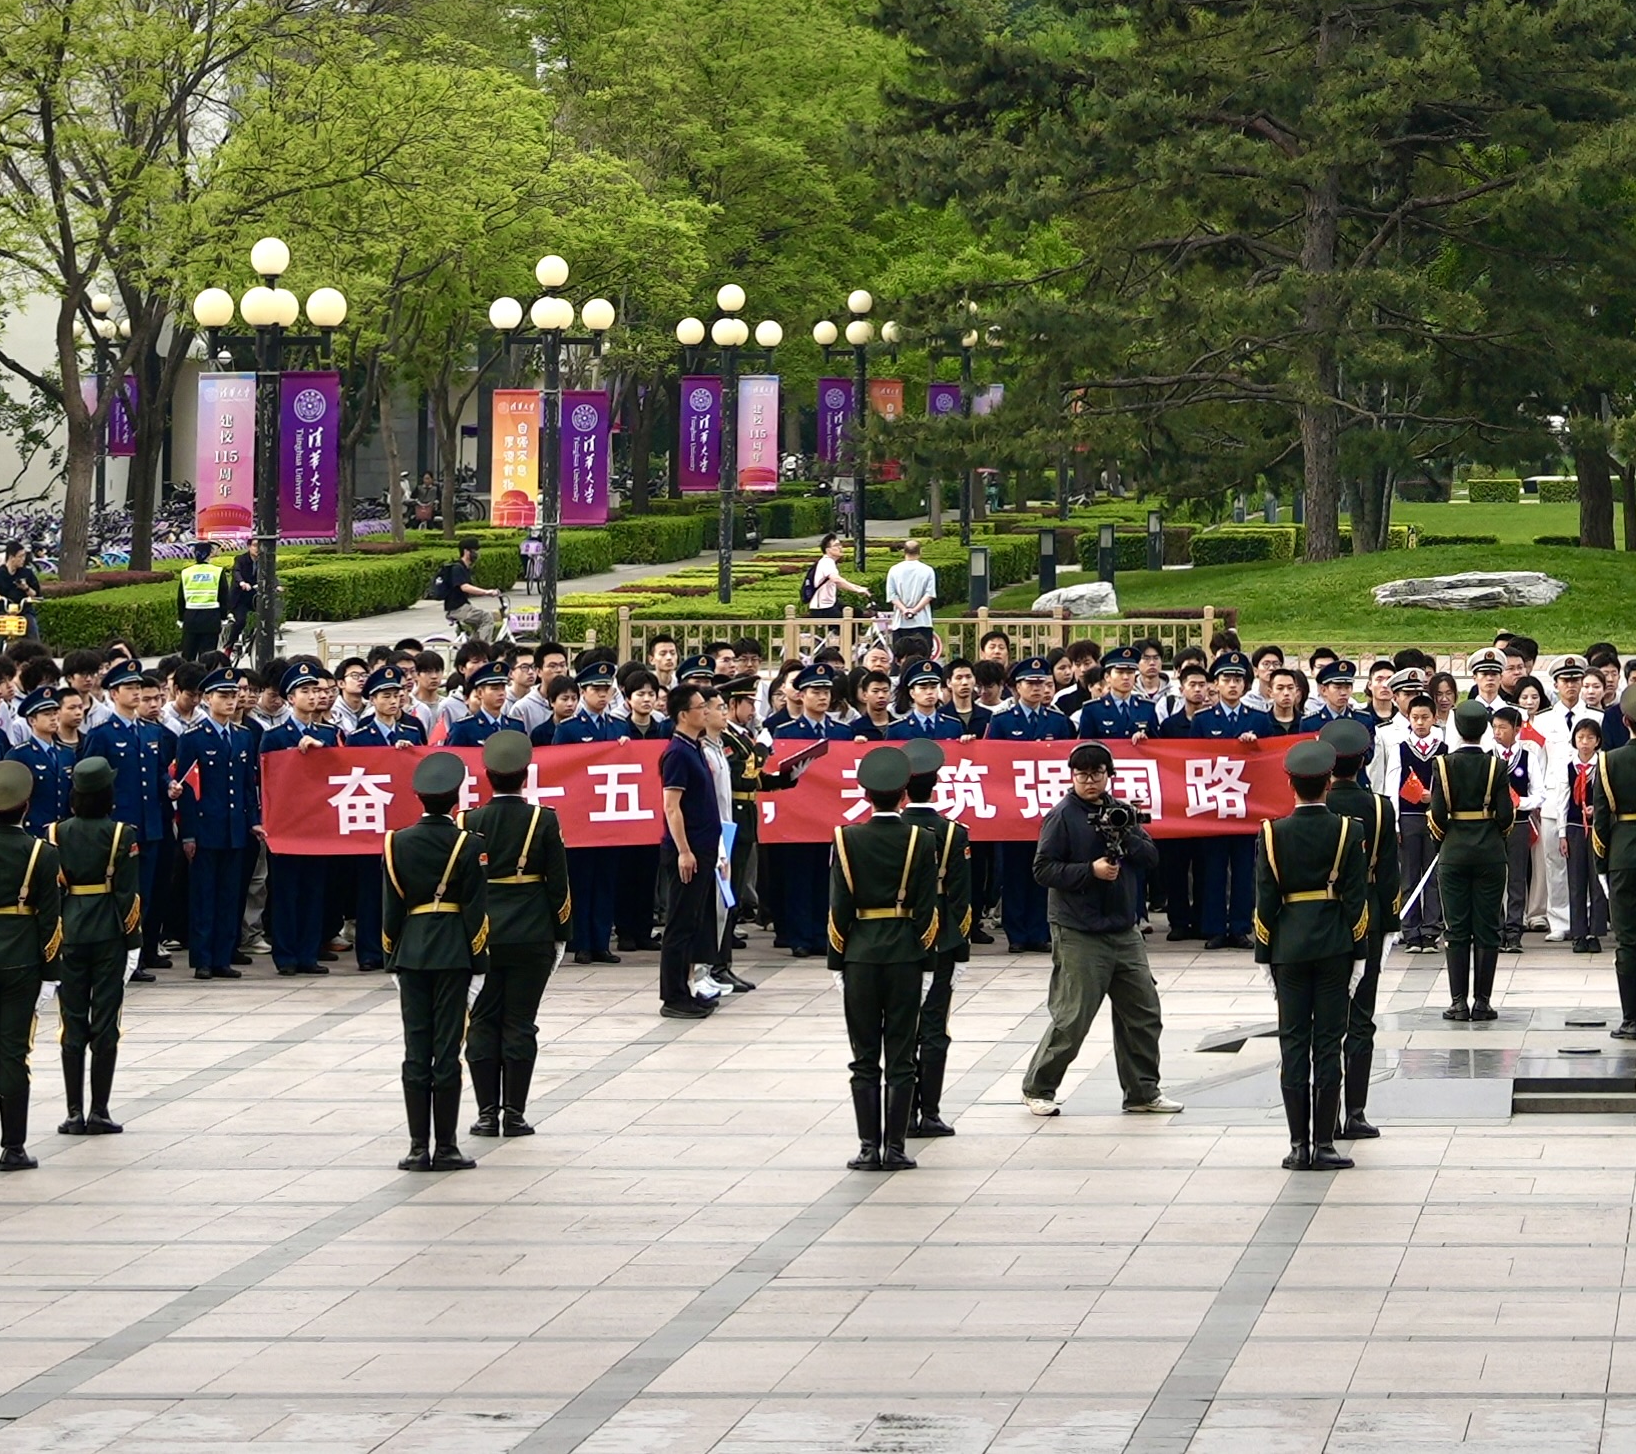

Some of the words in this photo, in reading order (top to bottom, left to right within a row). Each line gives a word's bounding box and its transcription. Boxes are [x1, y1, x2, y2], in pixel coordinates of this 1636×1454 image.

[214, 413, 240, 498] 建校115周年
[294, 428, 305, 466] Tsinghua
[293, 468, 304, 510] University
